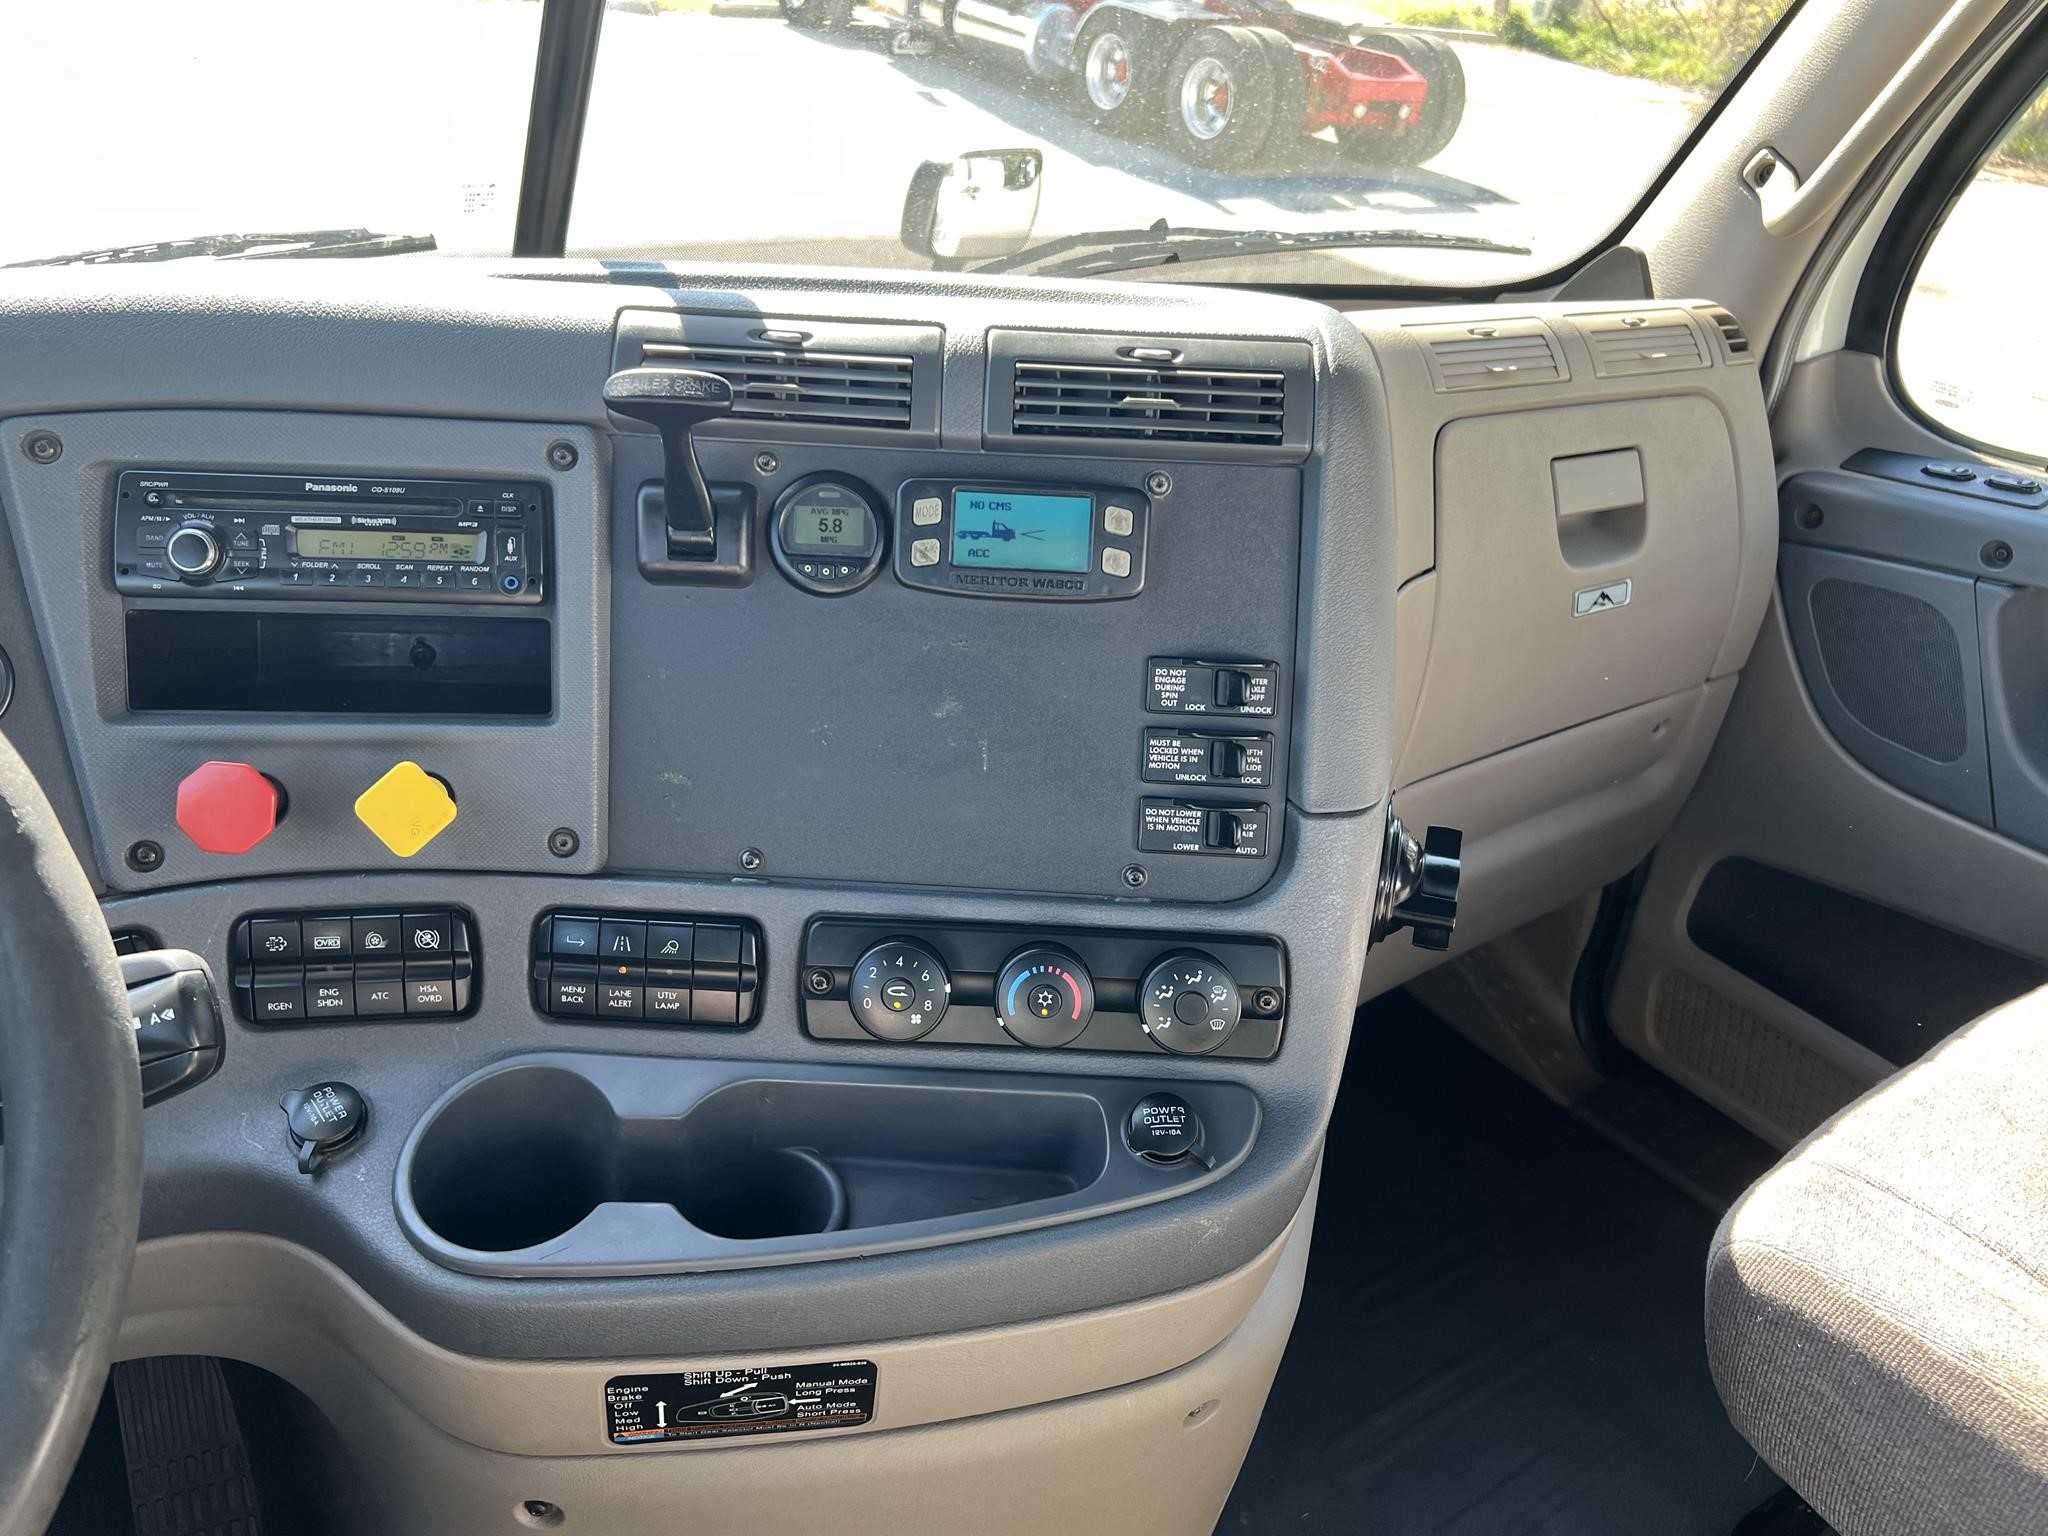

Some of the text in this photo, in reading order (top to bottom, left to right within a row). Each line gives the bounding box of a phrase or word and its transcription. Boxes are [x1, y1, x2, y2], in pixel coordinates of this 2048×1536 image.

[674, 378, 721, 394] BRAKE
[140, 480, 169, 488] SRC/PWR
[305, 482, 406, 494] Panasonic CQ-5109U
[915, 502, 940, 518] MODE
[969, 500, 1012, 512] NO CMS
[810, 507, 849, 516] AVG MPG
[818, 518, 843, 533] 5.8
[820, 535, 838, 544] MPG
[429, 542, 449, 555] PM
[968, 548, 990, 558] ACC
[293, 573, 299, 581] 1
[329, 574, 336, 582] 2
[365, 575, 371, 583] 3
[436, 576, 443, 585] 5
[471, 577, 478, 585] 6
[955, 574, 1085, 591] MERITOR WABCO
[1155, 668, 1168, 676] DO
[1155, 676, 1187, 684] ENGAGE
[1155, 684, 1186, 692] DURING
[1161, 699, 1178, 707] OUT
[1185, 703, 1206, 711] LOCK
[1240, 706, 1272, 714] UNLOCK
[1149, 747, 1179, 755] LOCKED
[1149, 754, 1179, 762] VEHICLE
[1148, 762, 1180, 770] MOTION
[1246, 764, 1262, 772] LIDE
[1175, 773, 1207, 782] UNLOCK
[1171, 817, 1201, 825] VEHICLE
[1173, 843, 1200, 851] LOWER
[1235, 847, 1258, 855] AUTO
[315, 937, 341, 948] OVRD
[896, 955, 903, 967] 4
[869, 966, 877, 979] 2
[921, 969, 930, 982] 6
[319, 988, 339, 997] ENG
[420, 985, 439, 993] HSA
[560, 985, 586, 994] MENU
[609, 989, 632, 998] LANE
[371, 991, 390, 1001] ATC
[417, 994, 443, 1003] OVRD
[561, 995, 584, 1004] BACK
[657, 991, 678, 1000] UTLY
[267, 1002, 293, 1012] RGEN
[317, 998, 343, 1008] SHDN
[608, 999, 633, 1008] ALERT
[655, 1001, 680, 1010] LAMP
[863, 997, 872, 1009] 0
[924, 1000, 932, 1011] 8
[313, 1091, 338, 1122] OUTLET
[323, 1086, 348, 1119] POWER
[1143, 1106, 1185, 1115] POWER
[1143, 1115, 1186, 1125] OUTLET
[683, 1371, 711, 1380] Shift
[715, 1370, 732, 1378] Up
[745, 1367, 767, 1375] Pull
[683, 1378, 711, 1386] Shift
[715, 1376, 749, 1384] Down
[762, 1372, 792, 1380] Push
[796, 1378, 868, 1389] Manual Mode
[607, 1386, 649, 1395] Engine
[795, 1388, 822, 1397] Long
[607, 1394, 643, 1402] Brake
[613, 1402, 632, 1410] Off
[826, 1401, 857, 1409] Mode
[614, 1410, 639, 1418] Low
[796, 1410, 826, 1418] Short
[615, 1417, 641, 1425] Med
[616, 1424, 644, 1432] High
